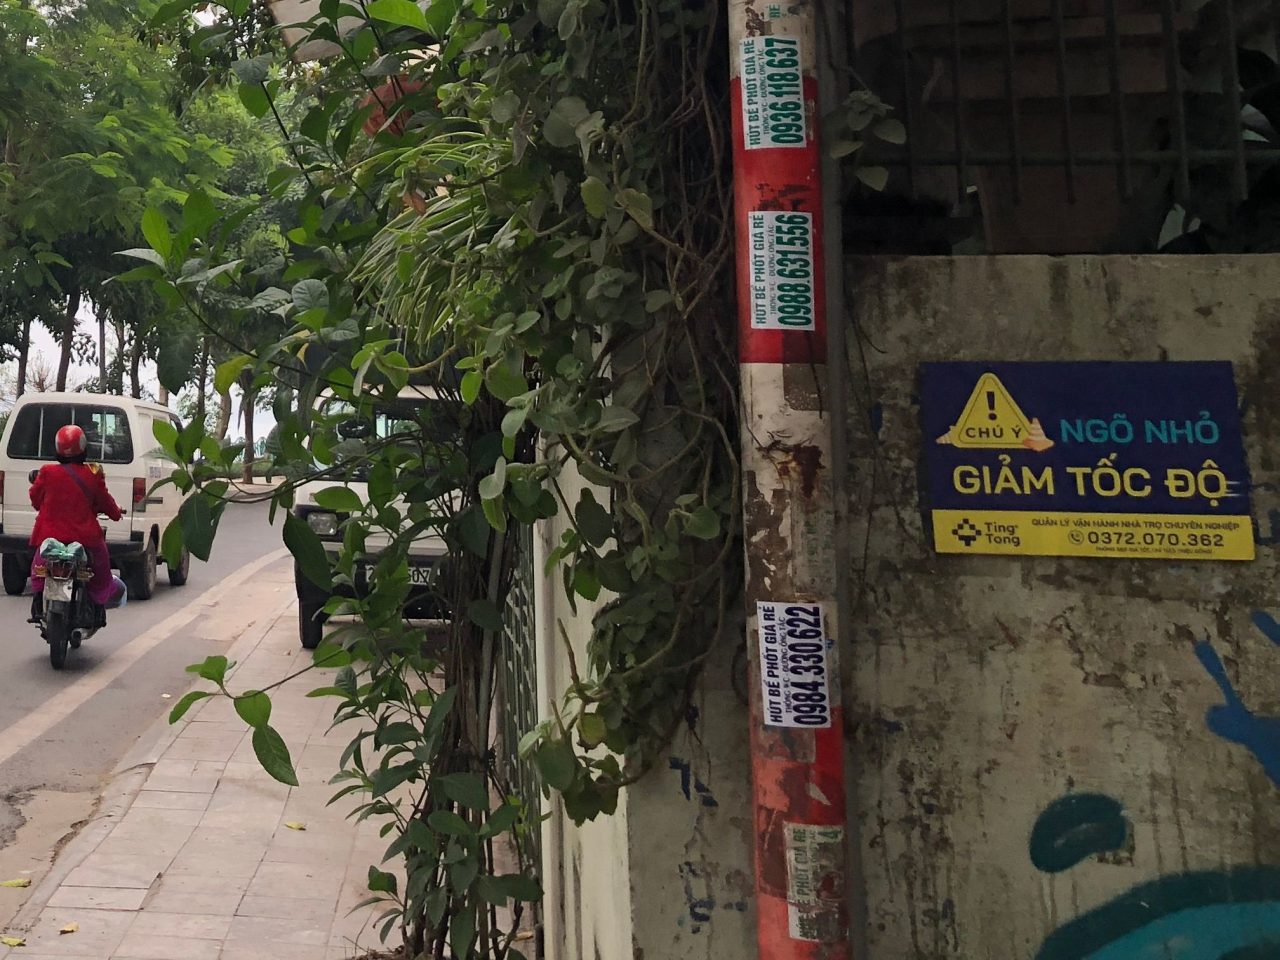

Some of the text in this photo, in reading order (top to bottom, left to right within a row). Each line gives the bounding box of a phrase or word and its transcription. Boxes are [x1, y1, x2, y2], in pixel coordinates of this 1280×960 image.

[742, 56, 756, 75] GIÁ
[764, 38, 804, 144] 0936.118.637
[746, 124, 761, 145] HÚT
[774, 214, 812, 326] 0988.631.556
[965, 424, 1022, 438] CHÚ Ý
[1060, 411, 1219, 445] NGÕ NHỎ
[952, 452, 1227, 507] GIẢM TỐC ĐỘ
[984, 521, 1015, 536] Ting
[1088, 530, 1224, 548] 0372.070.362
[985, 534, 1020, 546] Tong
[758, 605, 775, 621] RẺ
[761, 624, 776, 644] GIÁ
[762, 647, 780, 678] PHỐT
[785, 606, 828, 726] 0984.330.622
[766, 700, 783, 722] HÚT
